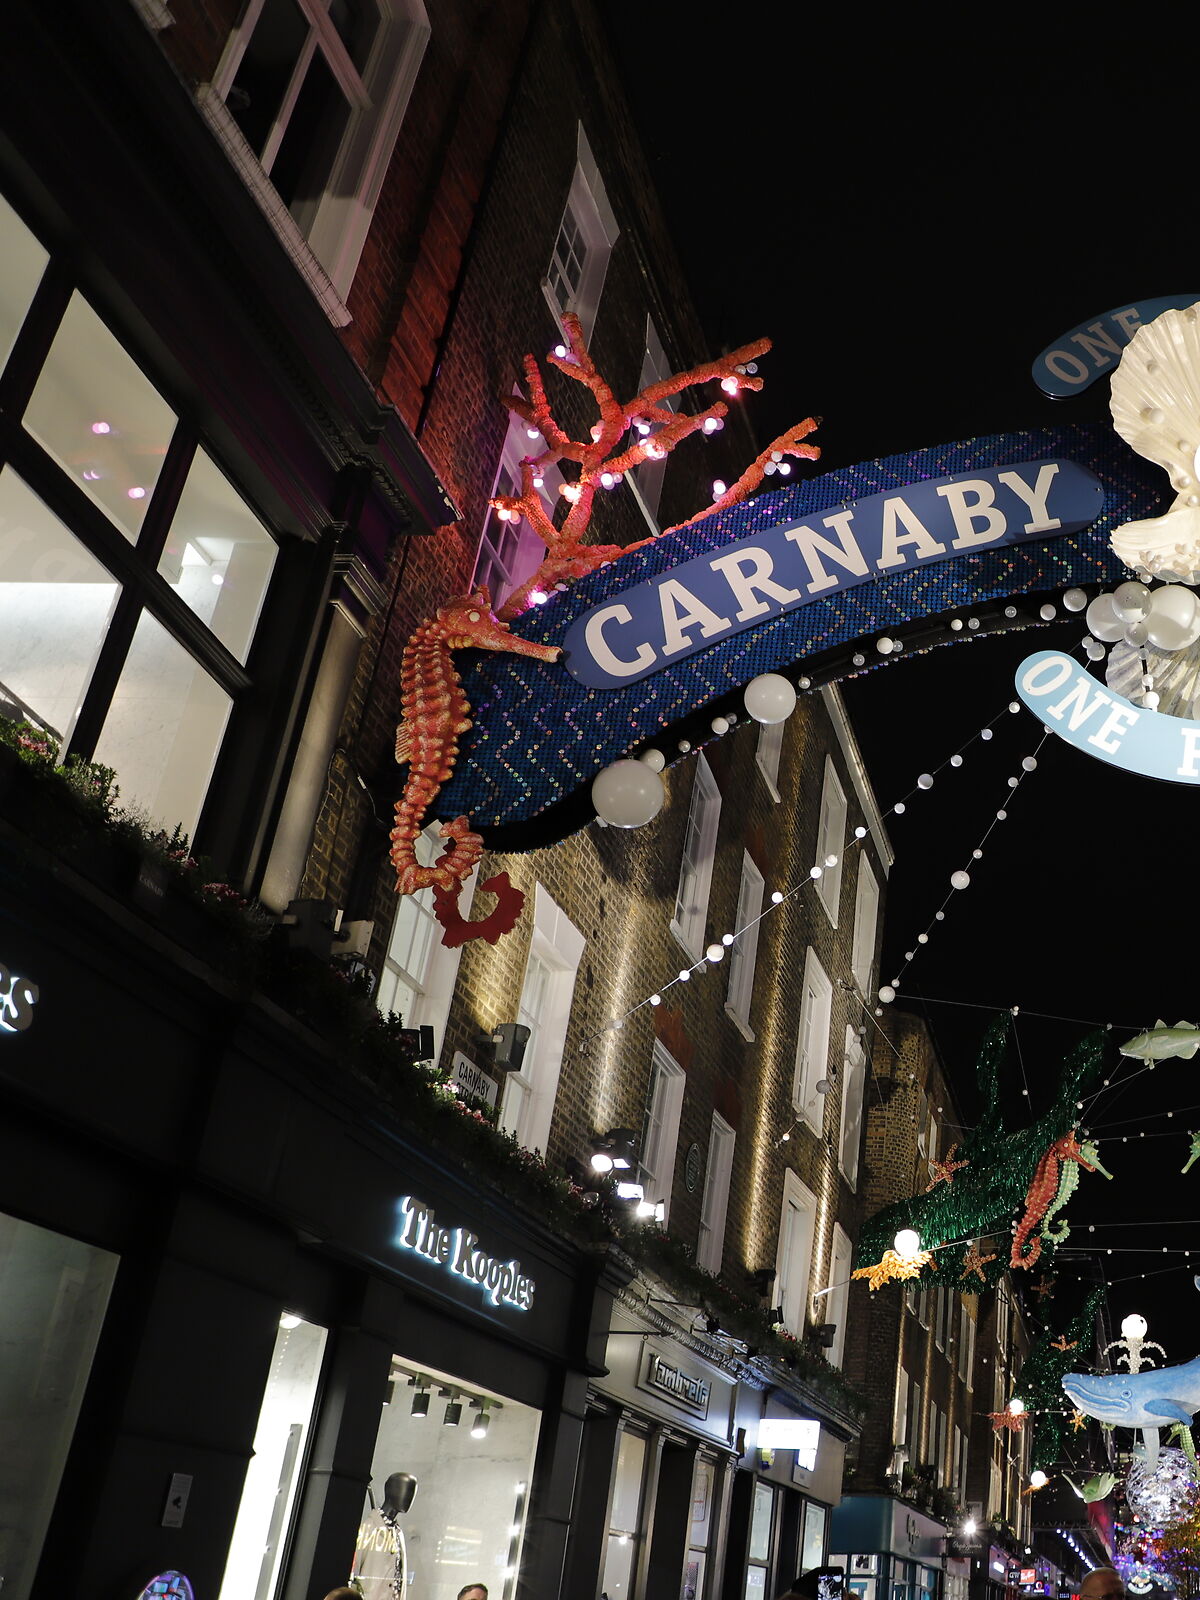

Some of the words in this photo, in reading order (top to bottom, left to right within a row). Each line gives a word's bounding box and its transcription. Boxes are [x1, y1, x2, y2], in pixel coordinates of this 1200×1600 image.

[584, 464, 1063, 678] CARNABY
[1021, 655, 1140, 755] ONE
[458, 1061, 490, 1099] CARNABY
[400, 1196, 450, 1264] The
[451, 1227, 535, 1311] Kooples
